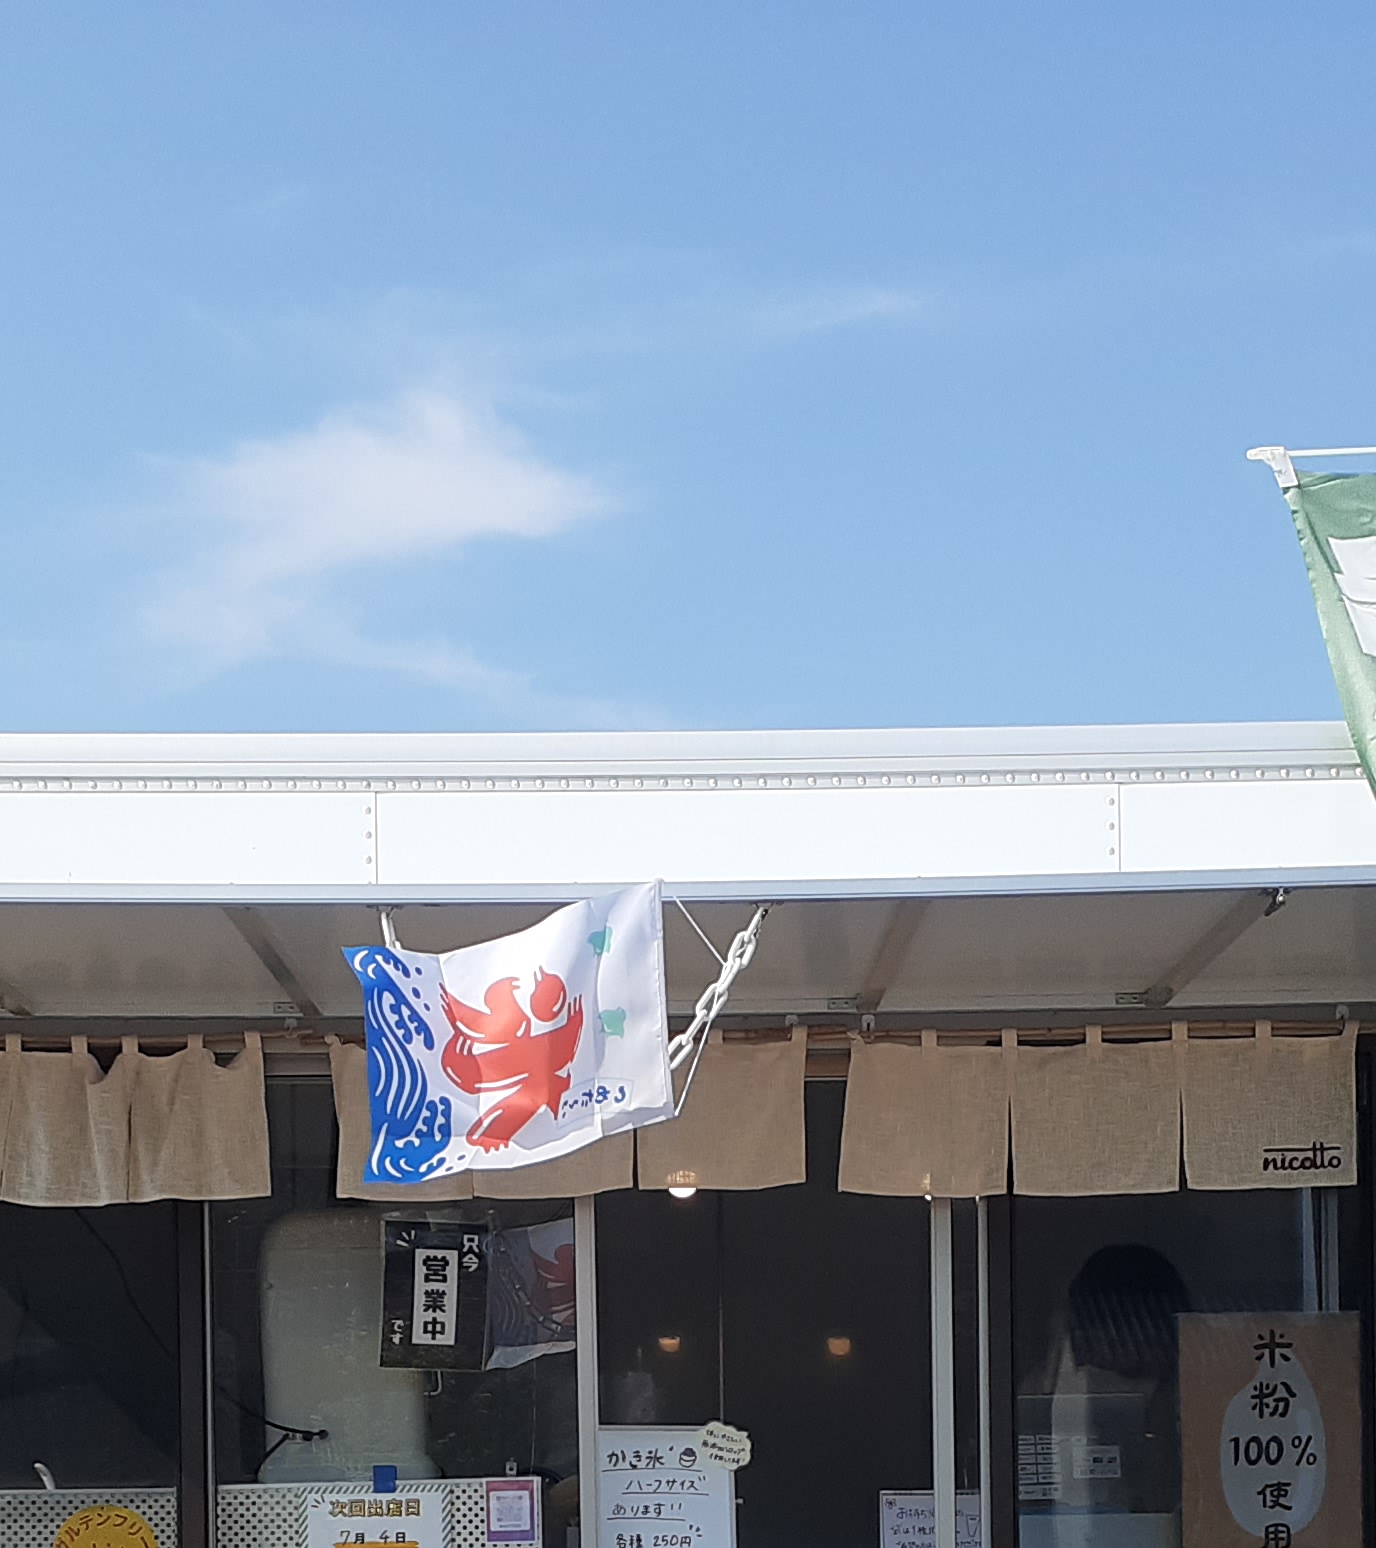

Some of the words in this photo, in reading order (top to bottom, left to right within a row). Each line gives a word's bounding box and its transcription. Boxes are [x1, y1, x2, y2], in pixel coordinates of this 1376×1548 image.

[1262, 1141, 1342, 1171] nicotto
[462, 1234, 480, 1272] 只今
[422, 1255, 450, 1340] 営業中
[390, 1319, 405, 1345] です
[606, 1448, 665, 1468] かき氷
[625, 1475, 706, 1493] ハーフサイズ
[328, 1498, 421, 1518] 次回出店日
[653, 1534, 692, 1548] 250円
